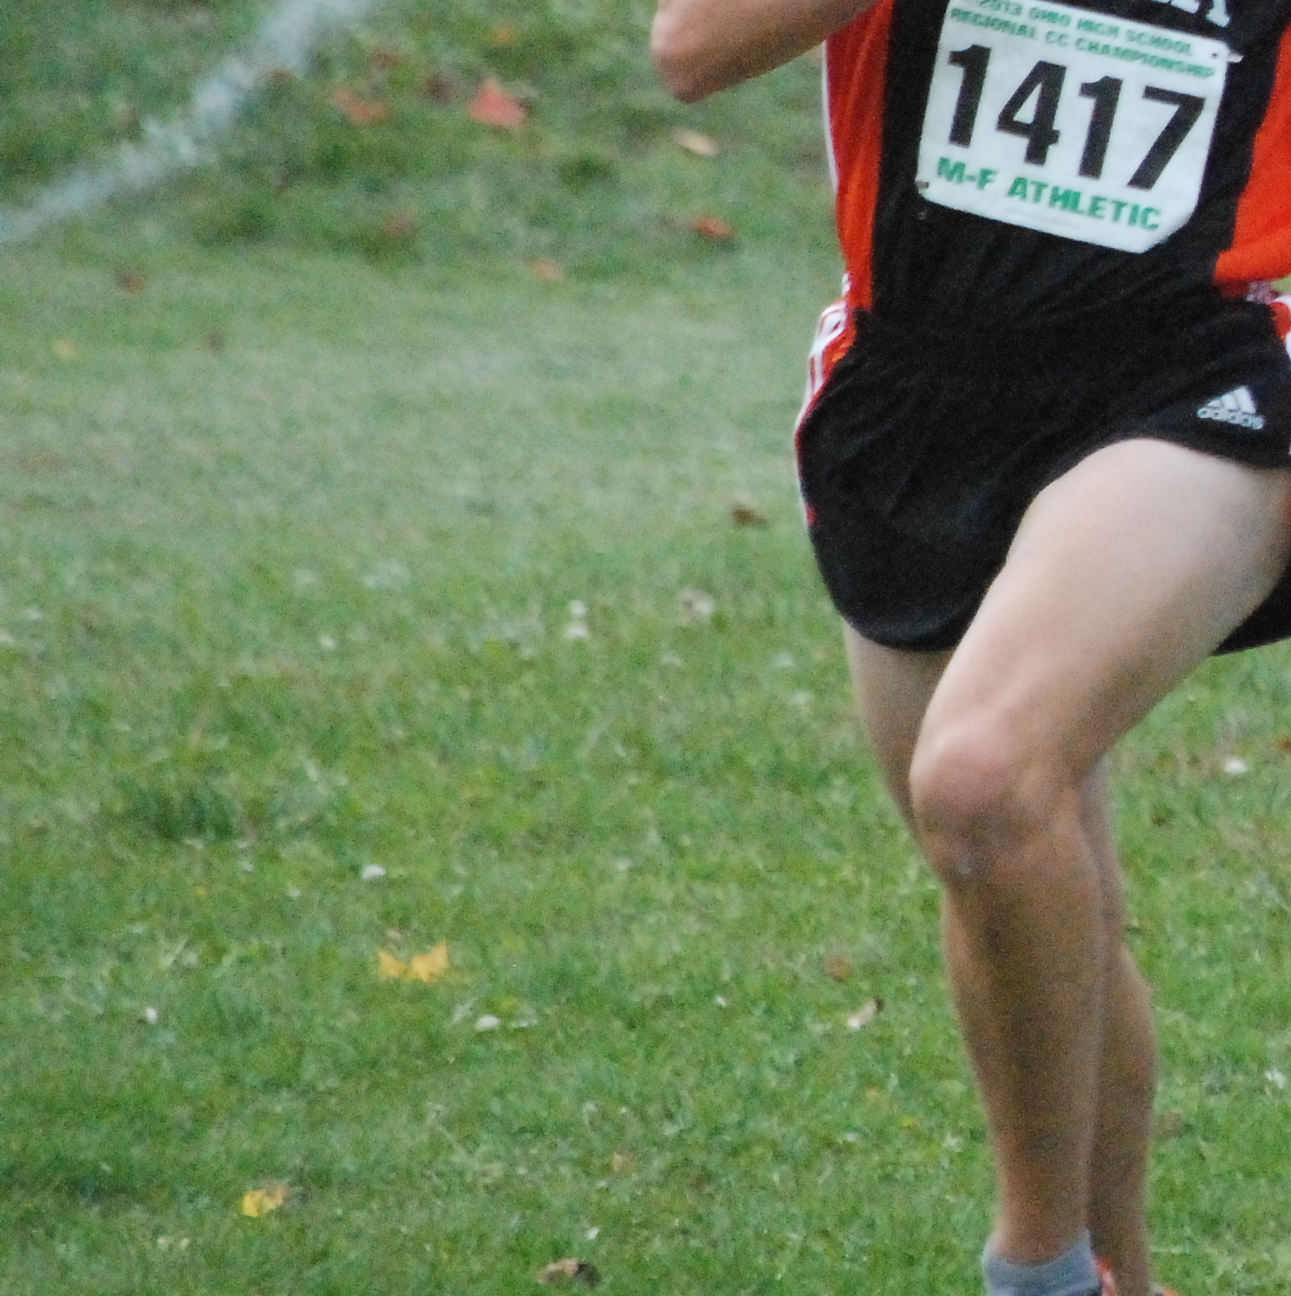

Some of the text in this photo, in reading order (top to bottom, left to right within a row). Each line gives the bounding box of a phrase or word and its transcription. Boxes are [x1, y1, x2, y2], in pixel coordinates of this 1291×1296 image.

[947, 43, 1207, 193] 1417
[936, 156, 1163, 232] M-F ATHLETIC
